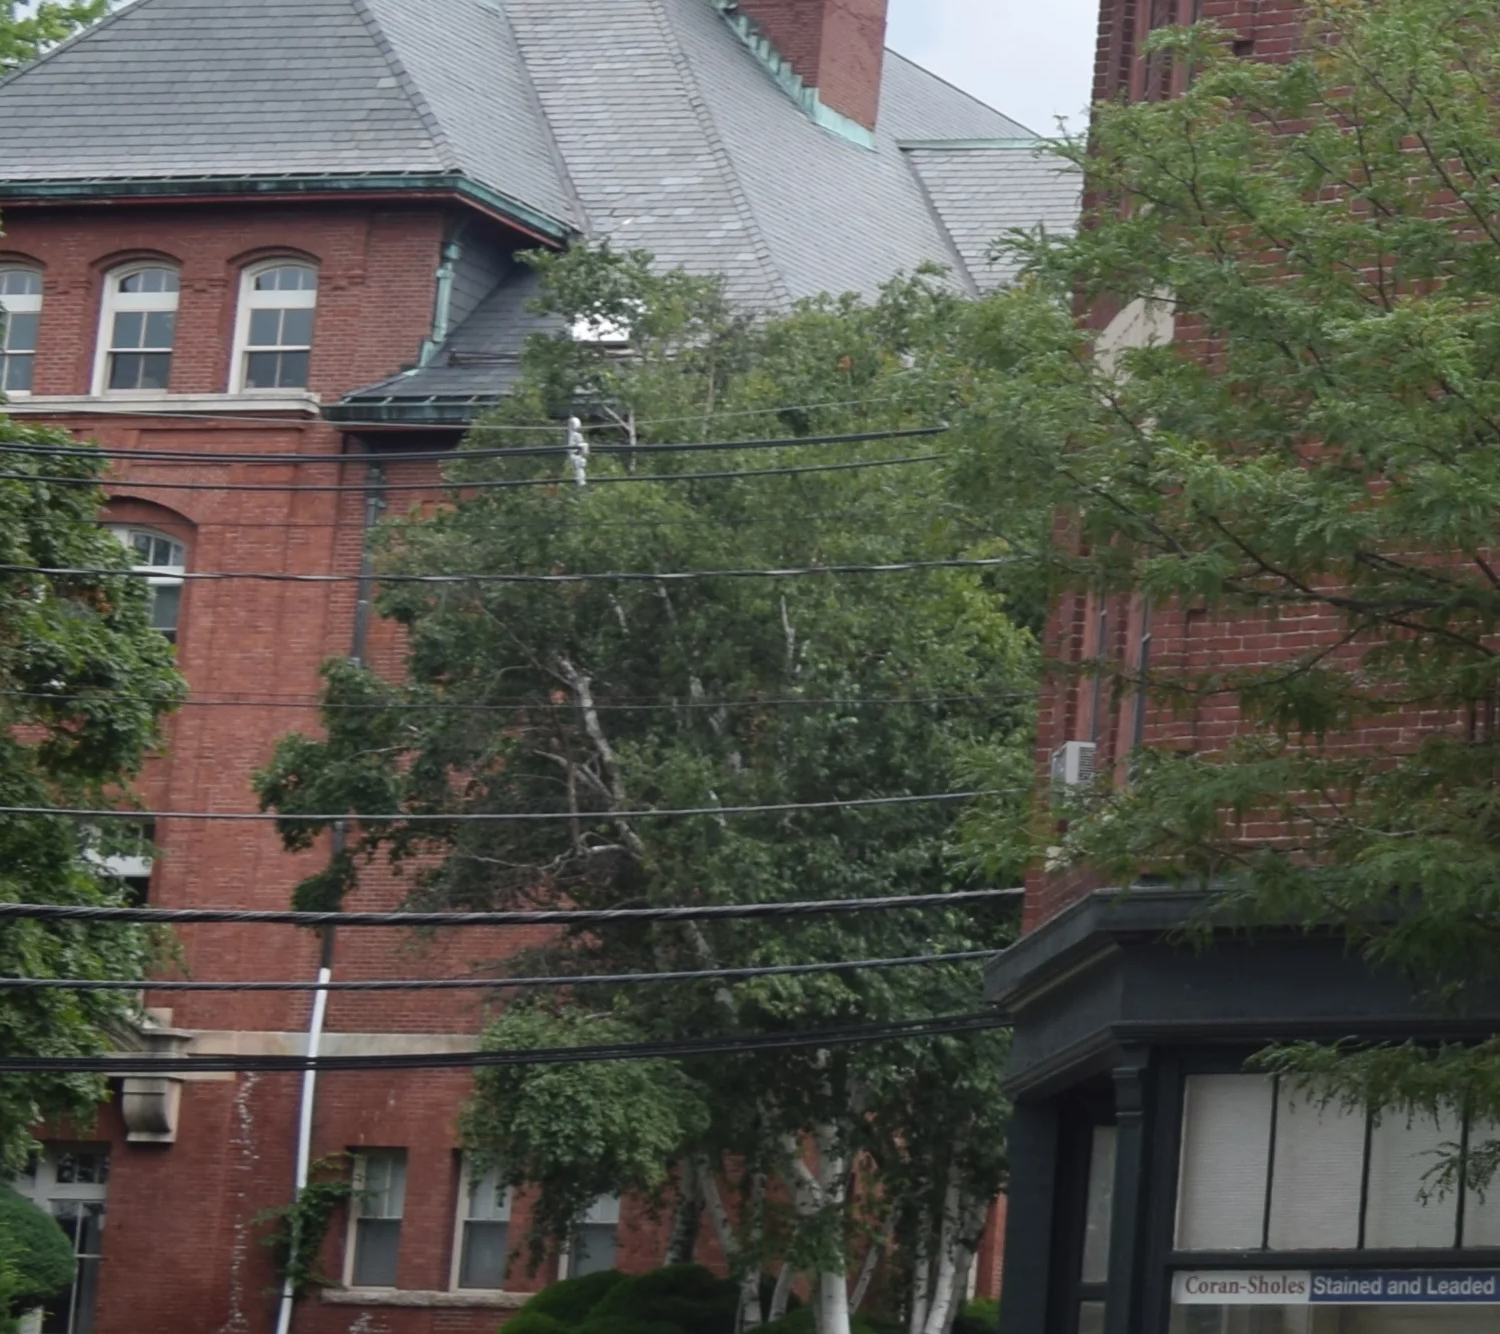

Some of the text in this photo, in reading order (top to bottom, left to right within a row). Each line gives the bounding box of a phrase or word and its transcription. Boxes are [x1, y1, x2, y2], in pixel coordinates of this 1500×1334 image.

[1184, 1275, 1306, 1296] Coran-Sholes
[1313, 1275, 1382, 1296] Stained
[1387, 1275, 1422, 1296] and
[1426, 1275, 1495, 1295] Leaded
